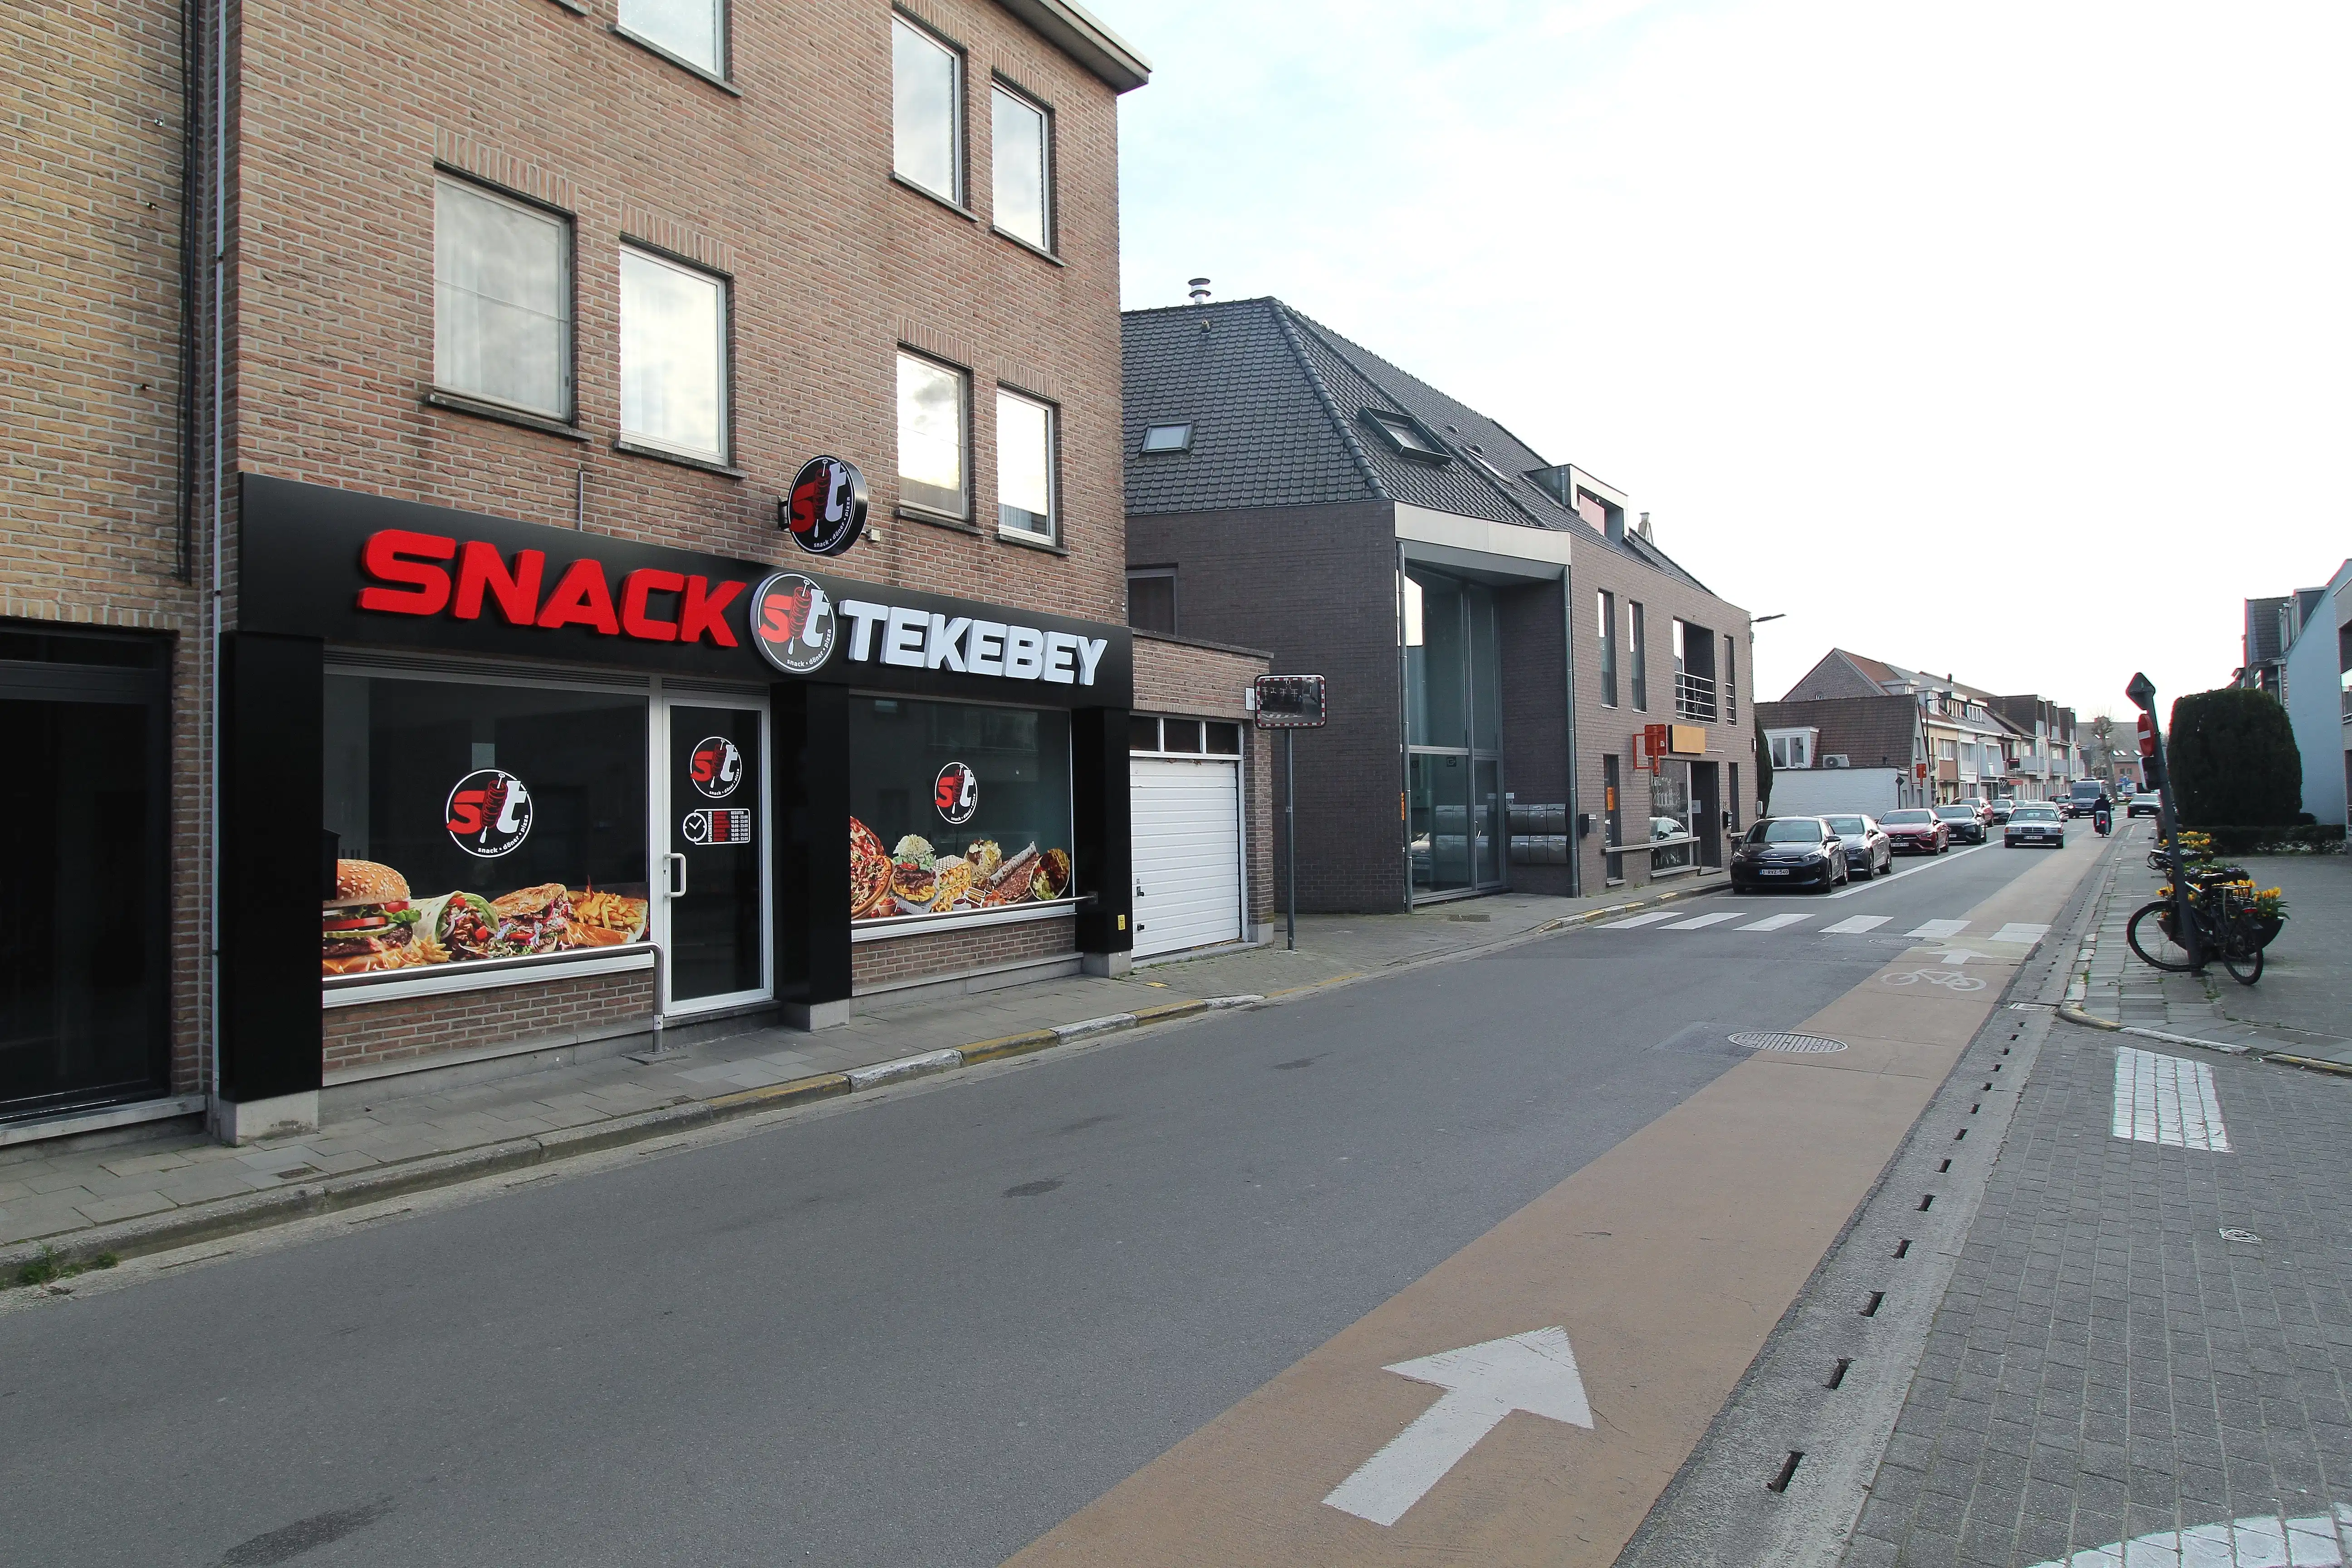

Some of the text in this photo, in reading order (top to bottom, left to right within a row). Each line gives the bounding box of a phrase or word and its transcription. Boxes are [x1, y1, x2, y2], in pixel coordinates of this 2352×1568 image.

[814, 539, 829, 548] snack
[833, 522, 845, 540] döner
[357, 529, 1108, 686] SNACK TEKEBEY
[786, 628, 832, 667] snack döner pizza
[503, 835, 519, 850] döner
[520, 814, 529, 833] pizza
